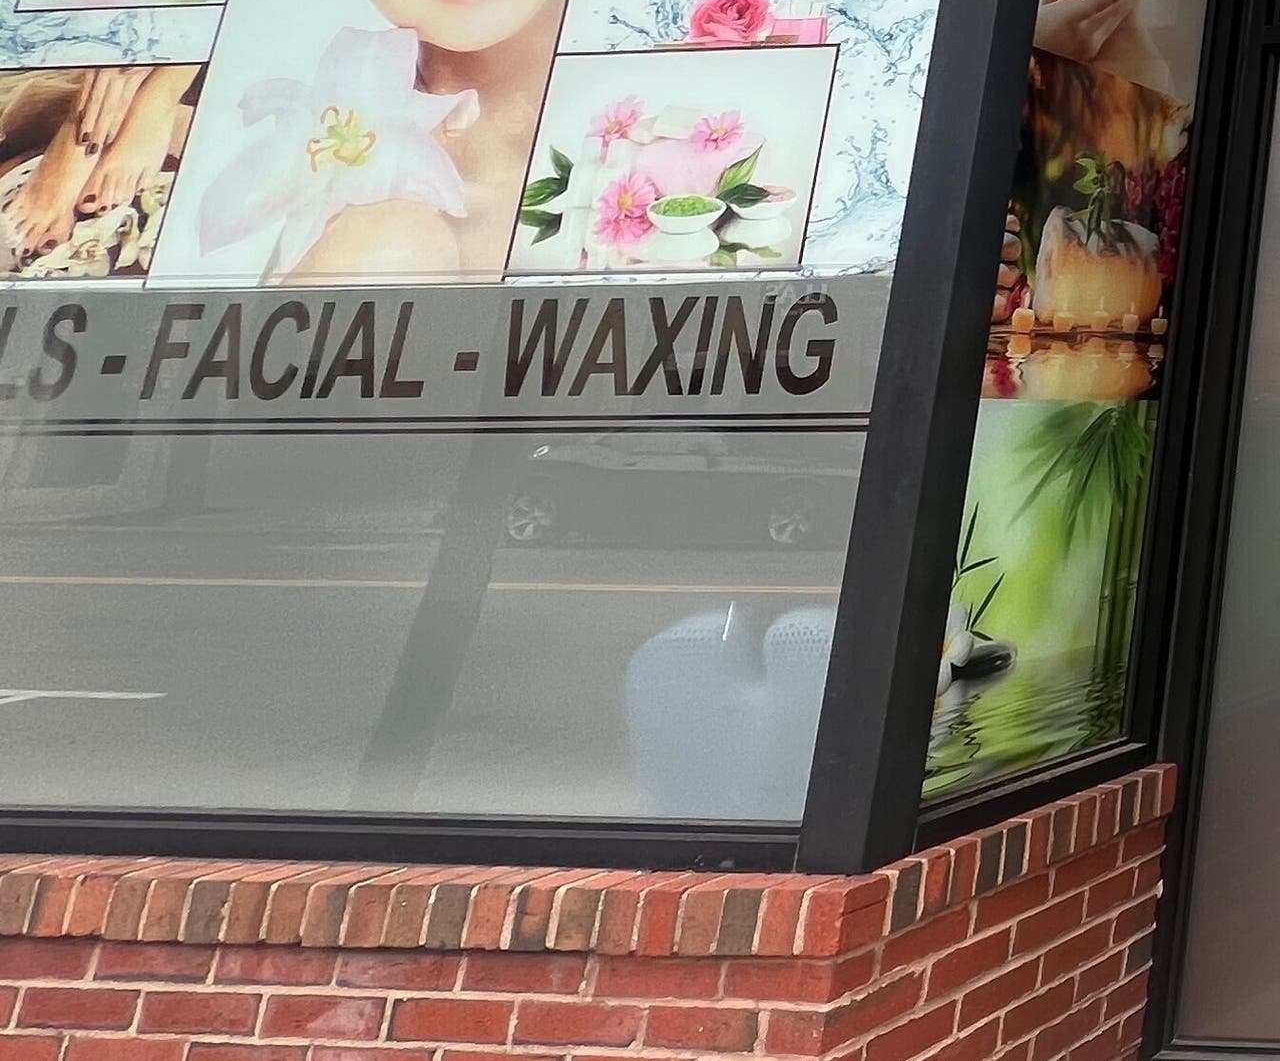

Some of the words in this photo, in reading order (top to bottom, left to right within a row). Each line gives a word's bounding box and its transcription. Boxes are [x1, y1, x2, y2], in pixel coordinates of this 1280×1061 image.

[100, 355, 128, 374] -
[139, 299, 427, 402] FACIAL
[453, 350, 481, 371] -
[502, 293, 838, 398] WAXING
